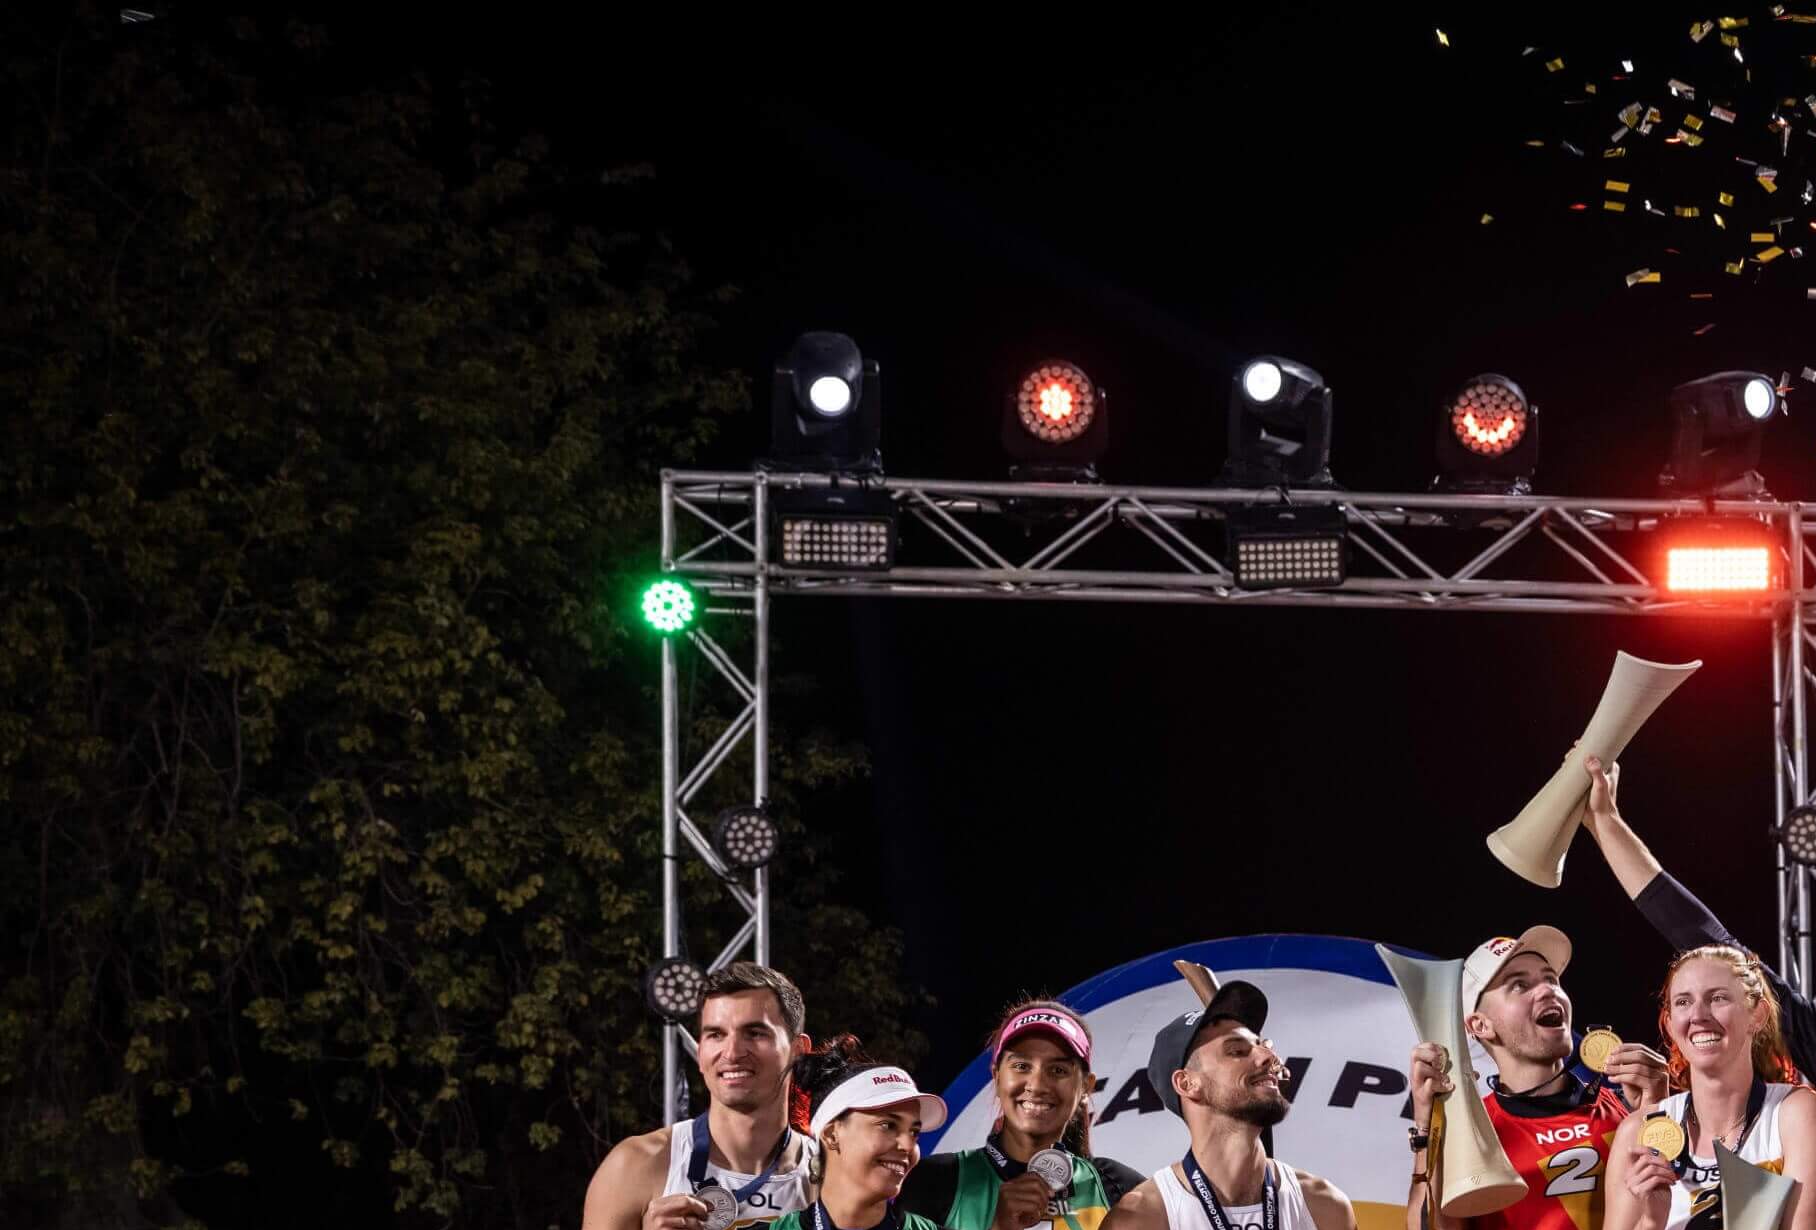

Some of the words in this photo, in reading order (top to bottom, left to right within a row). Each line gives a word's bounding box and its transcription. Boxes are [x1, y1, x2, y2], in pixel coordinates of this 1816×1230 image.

[1535, 1123, 1592, 1145] NOR
[1544, 1146, 1601, 1197] 2
[1692, 1167, 1720, 1184] US
[747, 1191, 782, 1211] OL
